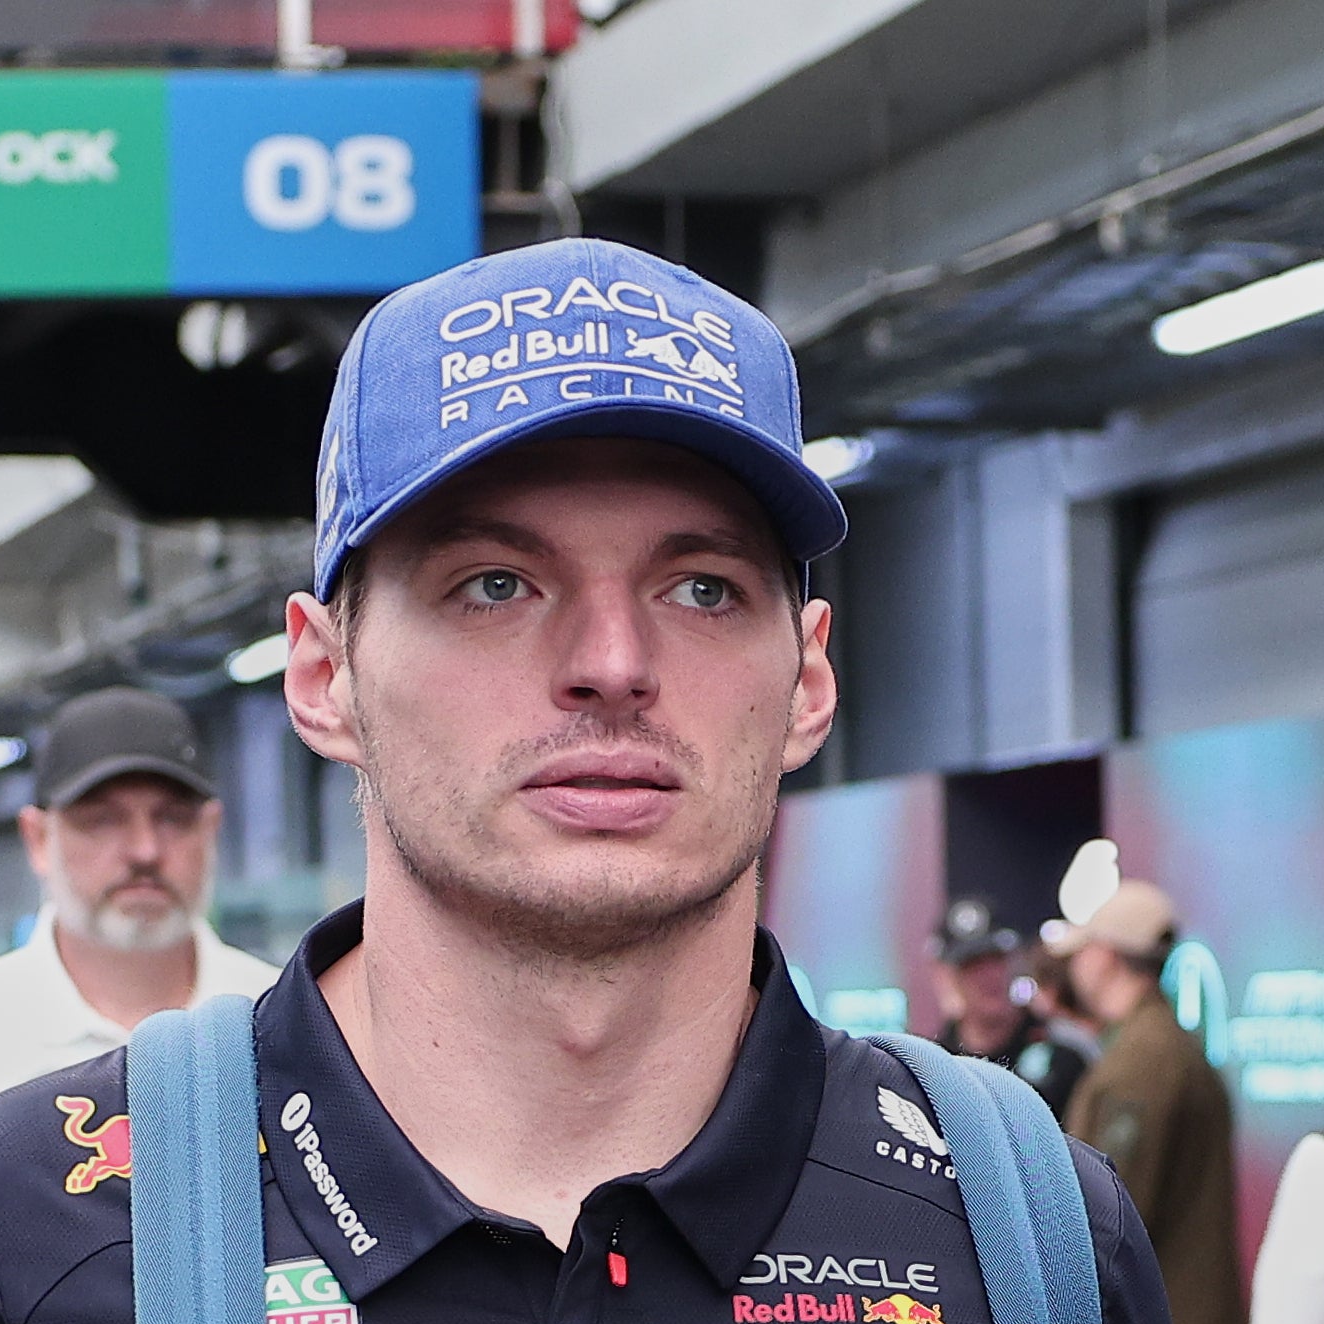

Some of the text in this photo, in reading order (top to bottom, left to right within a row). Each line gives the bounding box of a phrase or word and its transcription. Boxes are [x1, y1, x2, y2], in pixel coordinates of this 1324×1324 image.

[243, 133, 417, 231] 08
[439, 276, 736, 353] ORACLE
[441, 321, 610, 389] Red Bull
[293, 1122, 379, 1257] 1Password
[876, 1140, 957, 1180] CASTO
[265, 1267, 342, 1305] AG
[732, 1293, 857, 1324] Red Bull
